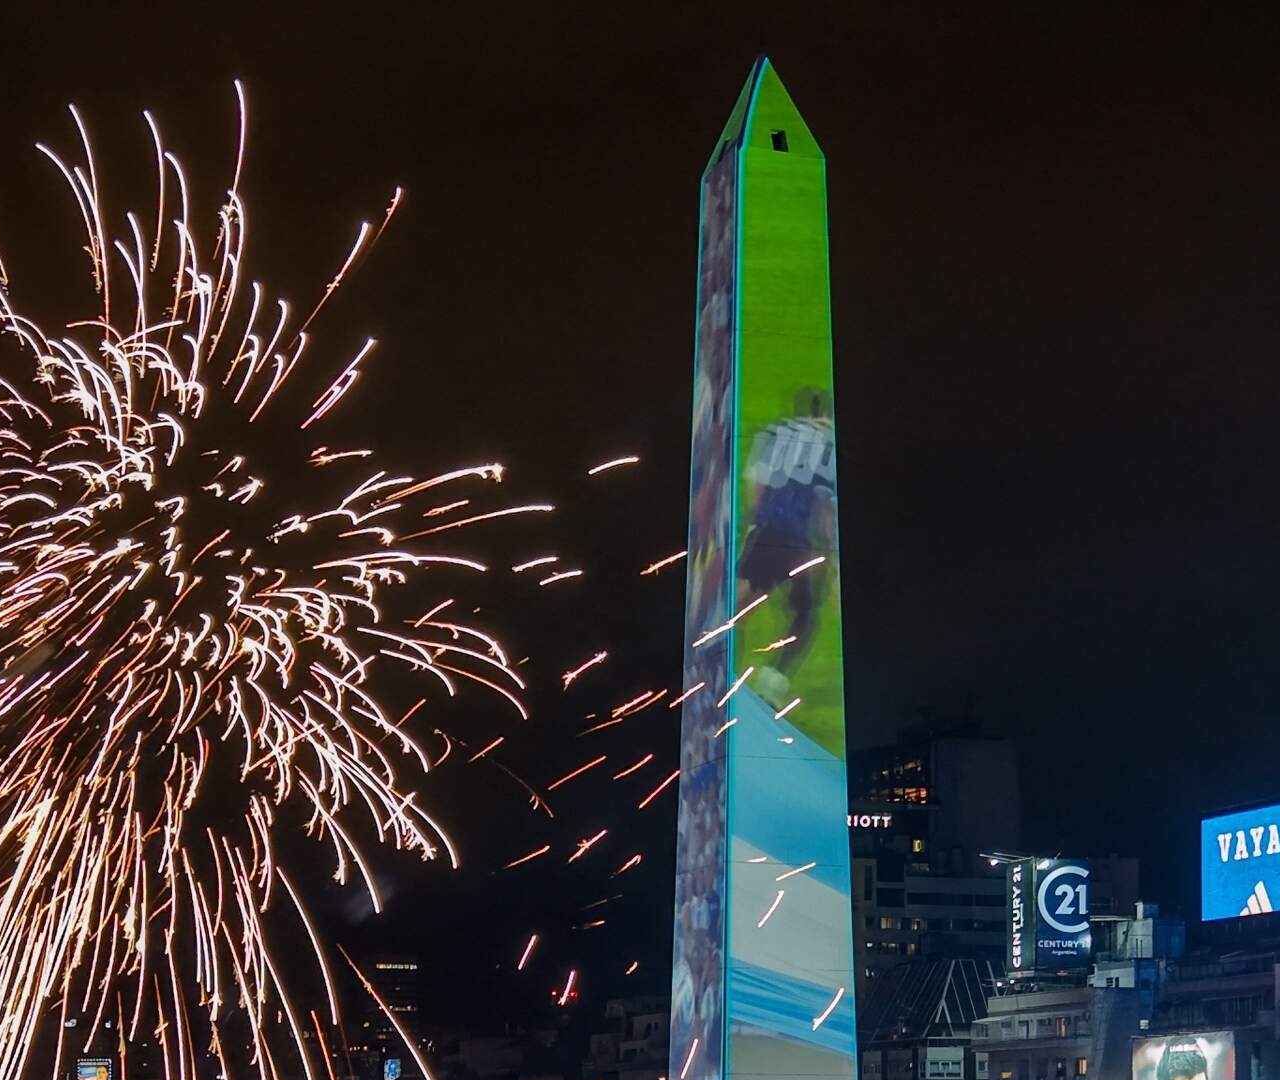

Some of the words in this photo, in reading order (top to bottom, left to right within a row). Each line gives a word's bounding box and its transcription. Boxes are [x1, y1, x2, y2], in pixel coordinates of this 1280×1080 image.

[1055, 884, 1089, 915] 21
[1012, 886, 1023, 968] CENTURY
[1038, 940, 1079, 949] CENTURY
